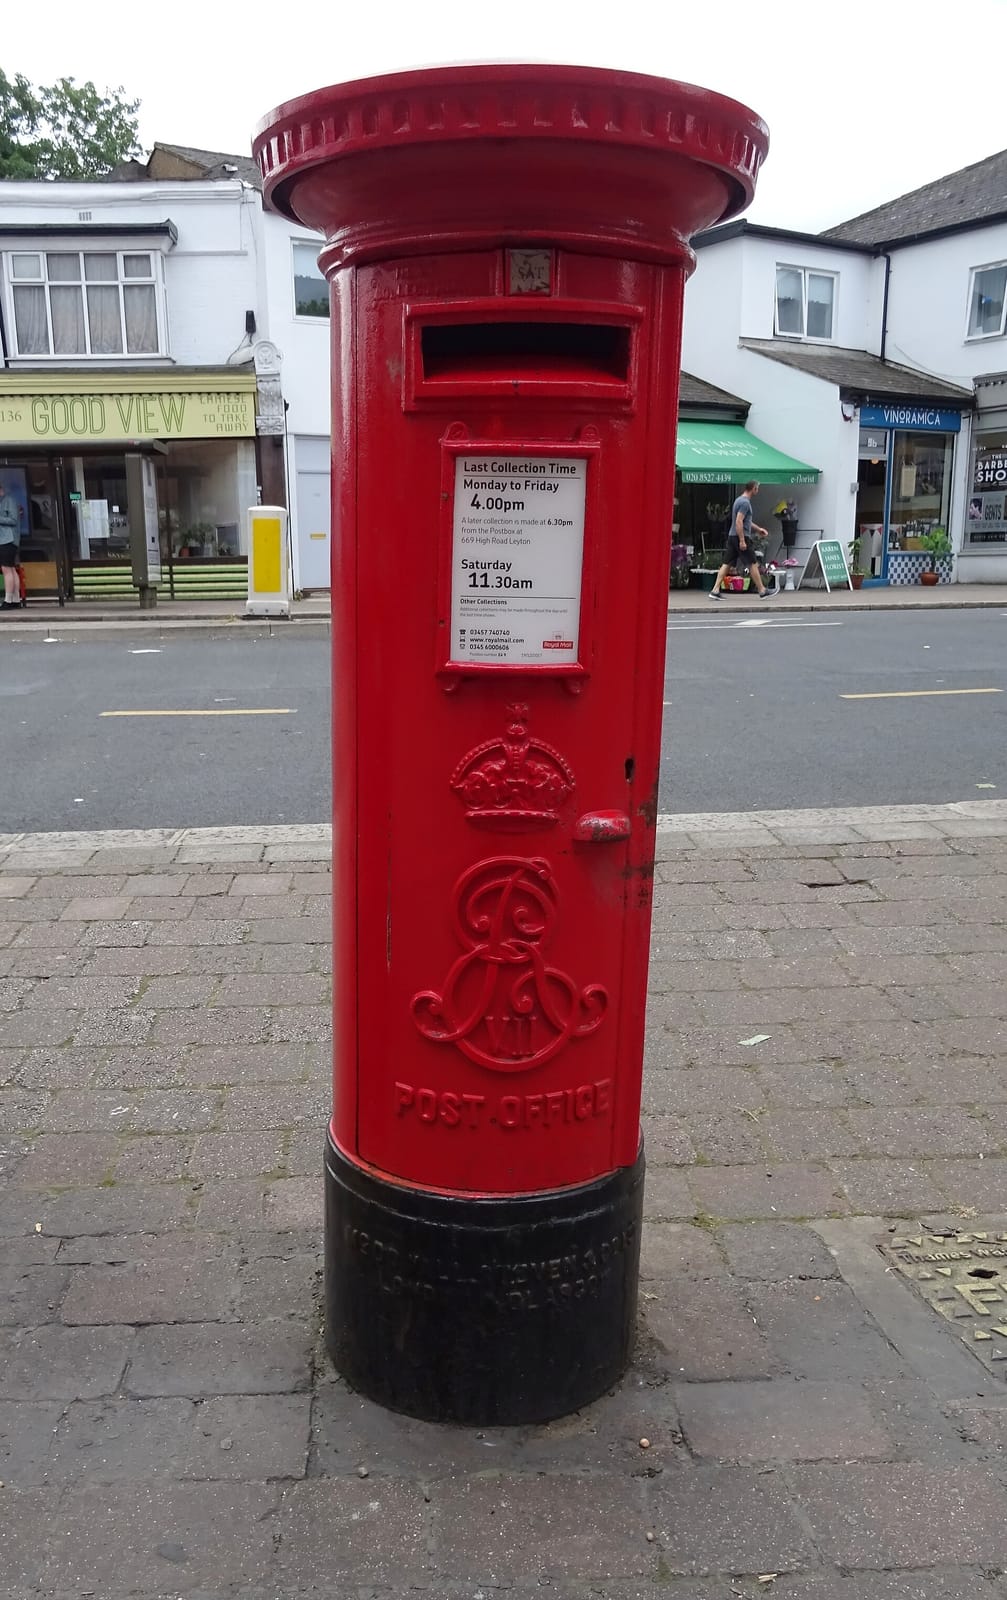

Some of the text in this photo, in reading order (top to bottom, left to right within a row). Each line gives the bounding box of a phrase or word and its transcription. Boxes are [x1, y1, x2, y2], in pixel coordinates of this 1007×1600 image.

[217, 404, 247, 414] FOOD
[0, 410, 22, 422] 136
[31, 396, 186, 435] GOOD VIEW
[203, 413, 248, 423] TO TAKE
[883, 409, 941, 426] VINORAMICA
[216, 423, 248, 433] AWAY
[464, 462, 576, 474] Last Collection Time
[977, 470, 1007, 482] SHO
[463, 480, 559, 493] Monday to Friday
[470, 494, 525, 512] 4.00pm
[467, 517, 482, 525] later
[483, 517, 513, 526] collection
[521, 519, 539, 527] made
[540, 519, 546, 527] at
[547, 518, 574, 528] 6.30pm
[461, 527, 477, 535] from
[478, 527, 489, 535] the
[490, 527, 515, 535] Postbox
[461, 537, 531, 546] 669 High Road Leyton
[461, 559, 513, 572] Saturday
[468, 572, 533, 590] 11.30am
[477, 598, 508, 606] Collections
[469, 637, 525, 645] www.royalmail.com
[394, 1078, 611, 1130] POST OFFICE
[898, 1251, 971, 1264] Thames
